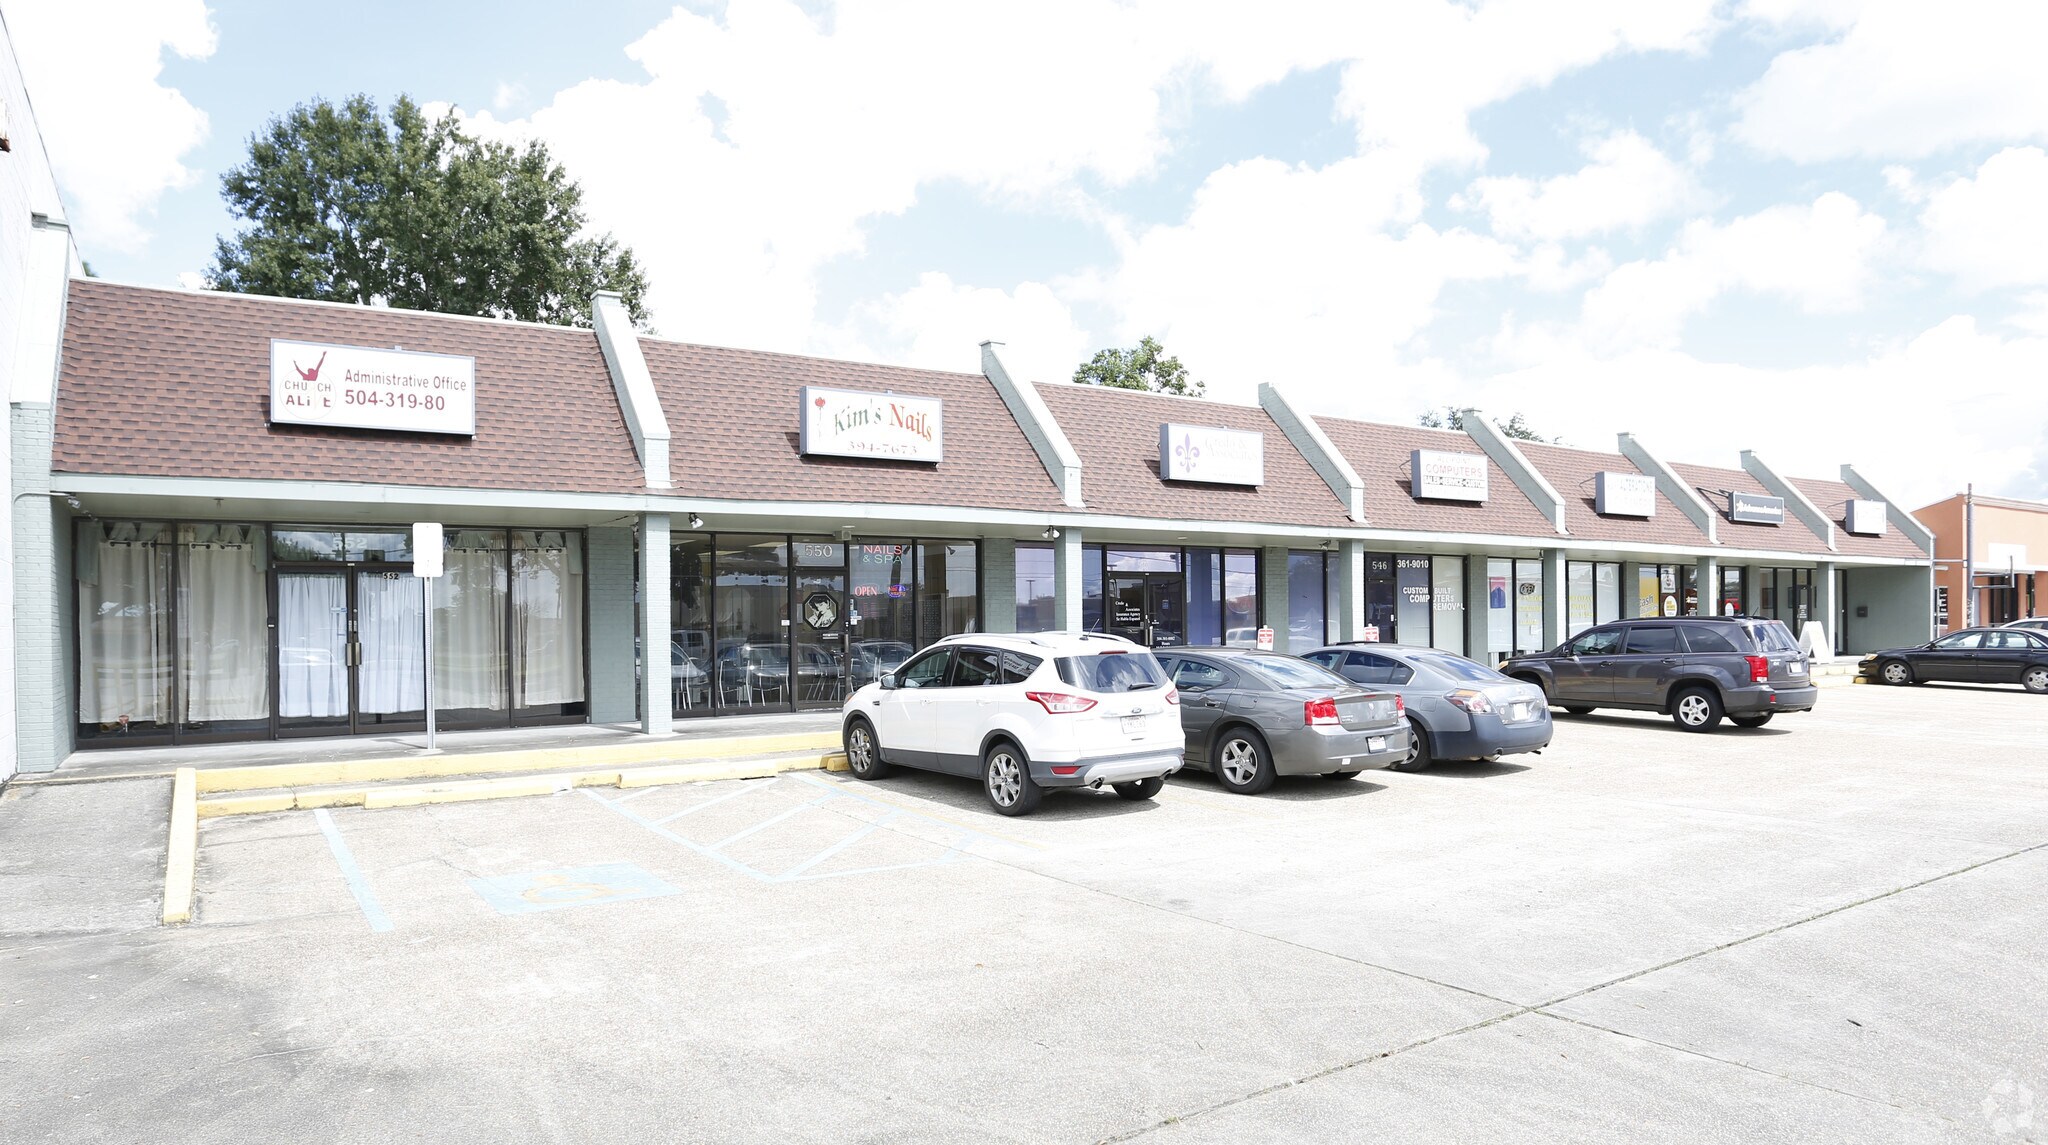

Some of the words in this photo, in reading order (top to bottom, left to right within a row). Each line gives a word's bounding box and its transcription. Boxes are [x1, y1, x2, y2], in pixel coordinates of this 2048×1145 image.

[284, 380, 331, 392] CHUCH
[344, 369, 429, 389] Administrative
[433, 376, 467, 391] Office
[345, 389, 445, 411] 504-319-80
[834, 398, 882, 435] Kim's
[889, 403, 932, 442] Nails
[1425, 463, 1483, 478] COMPUTERS
[333, 537, 367, 549] 552
[863, 544, 903, 554] NAILS
[805, 545, 832, 557] 550
[862, 555, 871, 563] &
[874, 554, 903, 563] SPA
[1397, 560, 1429, 568] 361-9010
[1372, 561, 1387, 570] 546
[383, 572, 399, 580] 552
[855, 586, 878, 596] OPEN
